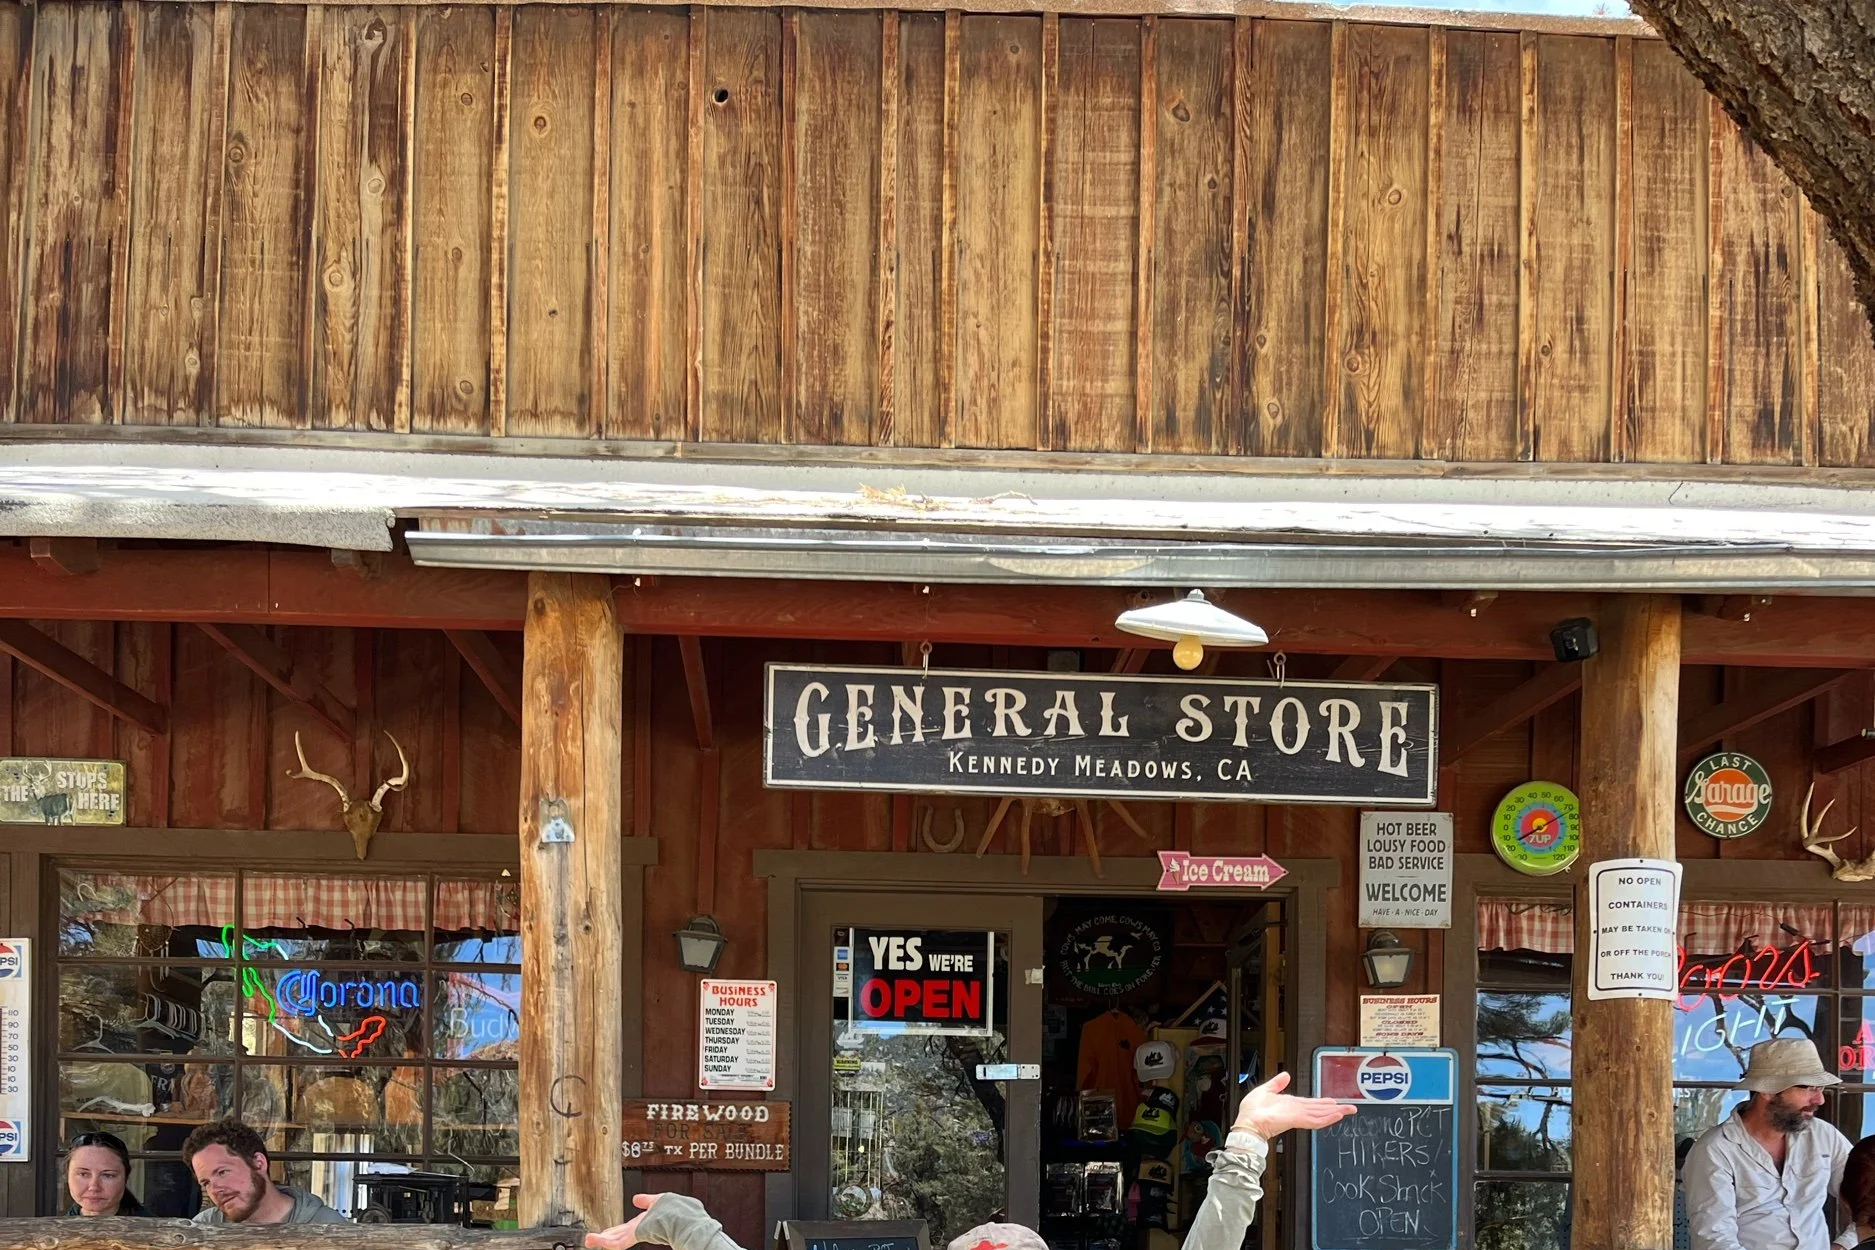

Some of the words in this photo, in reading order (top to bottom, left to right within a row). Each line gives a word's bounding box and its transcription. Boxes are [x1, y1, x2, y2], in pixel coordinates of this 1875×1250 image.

[793, 681, 1130, 758] GENERAL
[1174, 694, 1409, 778] STORE
[949, 752, 1059, 776] KENNEDY
[1075, 754, 1202, 782] MEADOWS,
[1217, 758, 1252, 781] CA
[1709, 756, 1752, 771] LAST
[57, 771, 107, 789] STOPS
[3, 785, 29, 801] THE
[1684, 771, 1771, 815] Garage
[78, 792, 119, 810] HERE
[1376, 822, 1402, 836] HOT
[1406, 822, 1437, 836] BEER
[1696, 812, 1758, 835] CHANCE
[1367, 839, 1406, 853] LOUSY
[1410, 840, 1446, 853] FOOD
[1369, 856, 1394, 870] BAD
[1398, 856, 1444, 870] SERVICE
[1182, 859, 1209, 882] Ice
[1212, 860, 1270, 882] Cream
[1618, 877, 1634, 885] NO
[1636, 877, 1662, 886] OPEN
[1365, 883, 1447, 903] WELCOME
[1608, 900, 1668, 911] CONTAINERS
[1601, 926, 1619, 934] MAY
[1636, 925, 1662, 933] TAKEN
[868, 936, 923, 971] YES
[928, 953, 974, 972] WE'RE
[0, 957, 18, 966] PSI
[1610, 972, 1644, 980] THANK
[276, 969, 419, 1017] Corona
[860, 977, 981, 1019] OPEN
[720, 997, 758, 1007] HOURS
[705, 1008, 735, 1016] MONDAY
[705, 1017, 735, 1026] TUESDAY
[1677, 998, 1800, 1056] IGHT
[705, 1027, 746, 1035] WEDNESDAY
[705, 1036, 740, 1044] THURSDAY
[704, 1045, 728, 1053] FRIDAY
[704, 1055, 739, 1063] SATURDAY
[704, 1064, 732, 1072] SUNDAY
[1361, 1072, 1408, 1084] PEPSI
[647, 1103, 769, 1123] FIREWOOD
[0, 1133, 17, 1141] PSI
[664, 1145, 683, 1155] TX
[689, 1142, 717, 1159] PER
[725, 1143, 784, 1160] BUNDLE
[1359, 1207, 1420, 1236] OPEN
